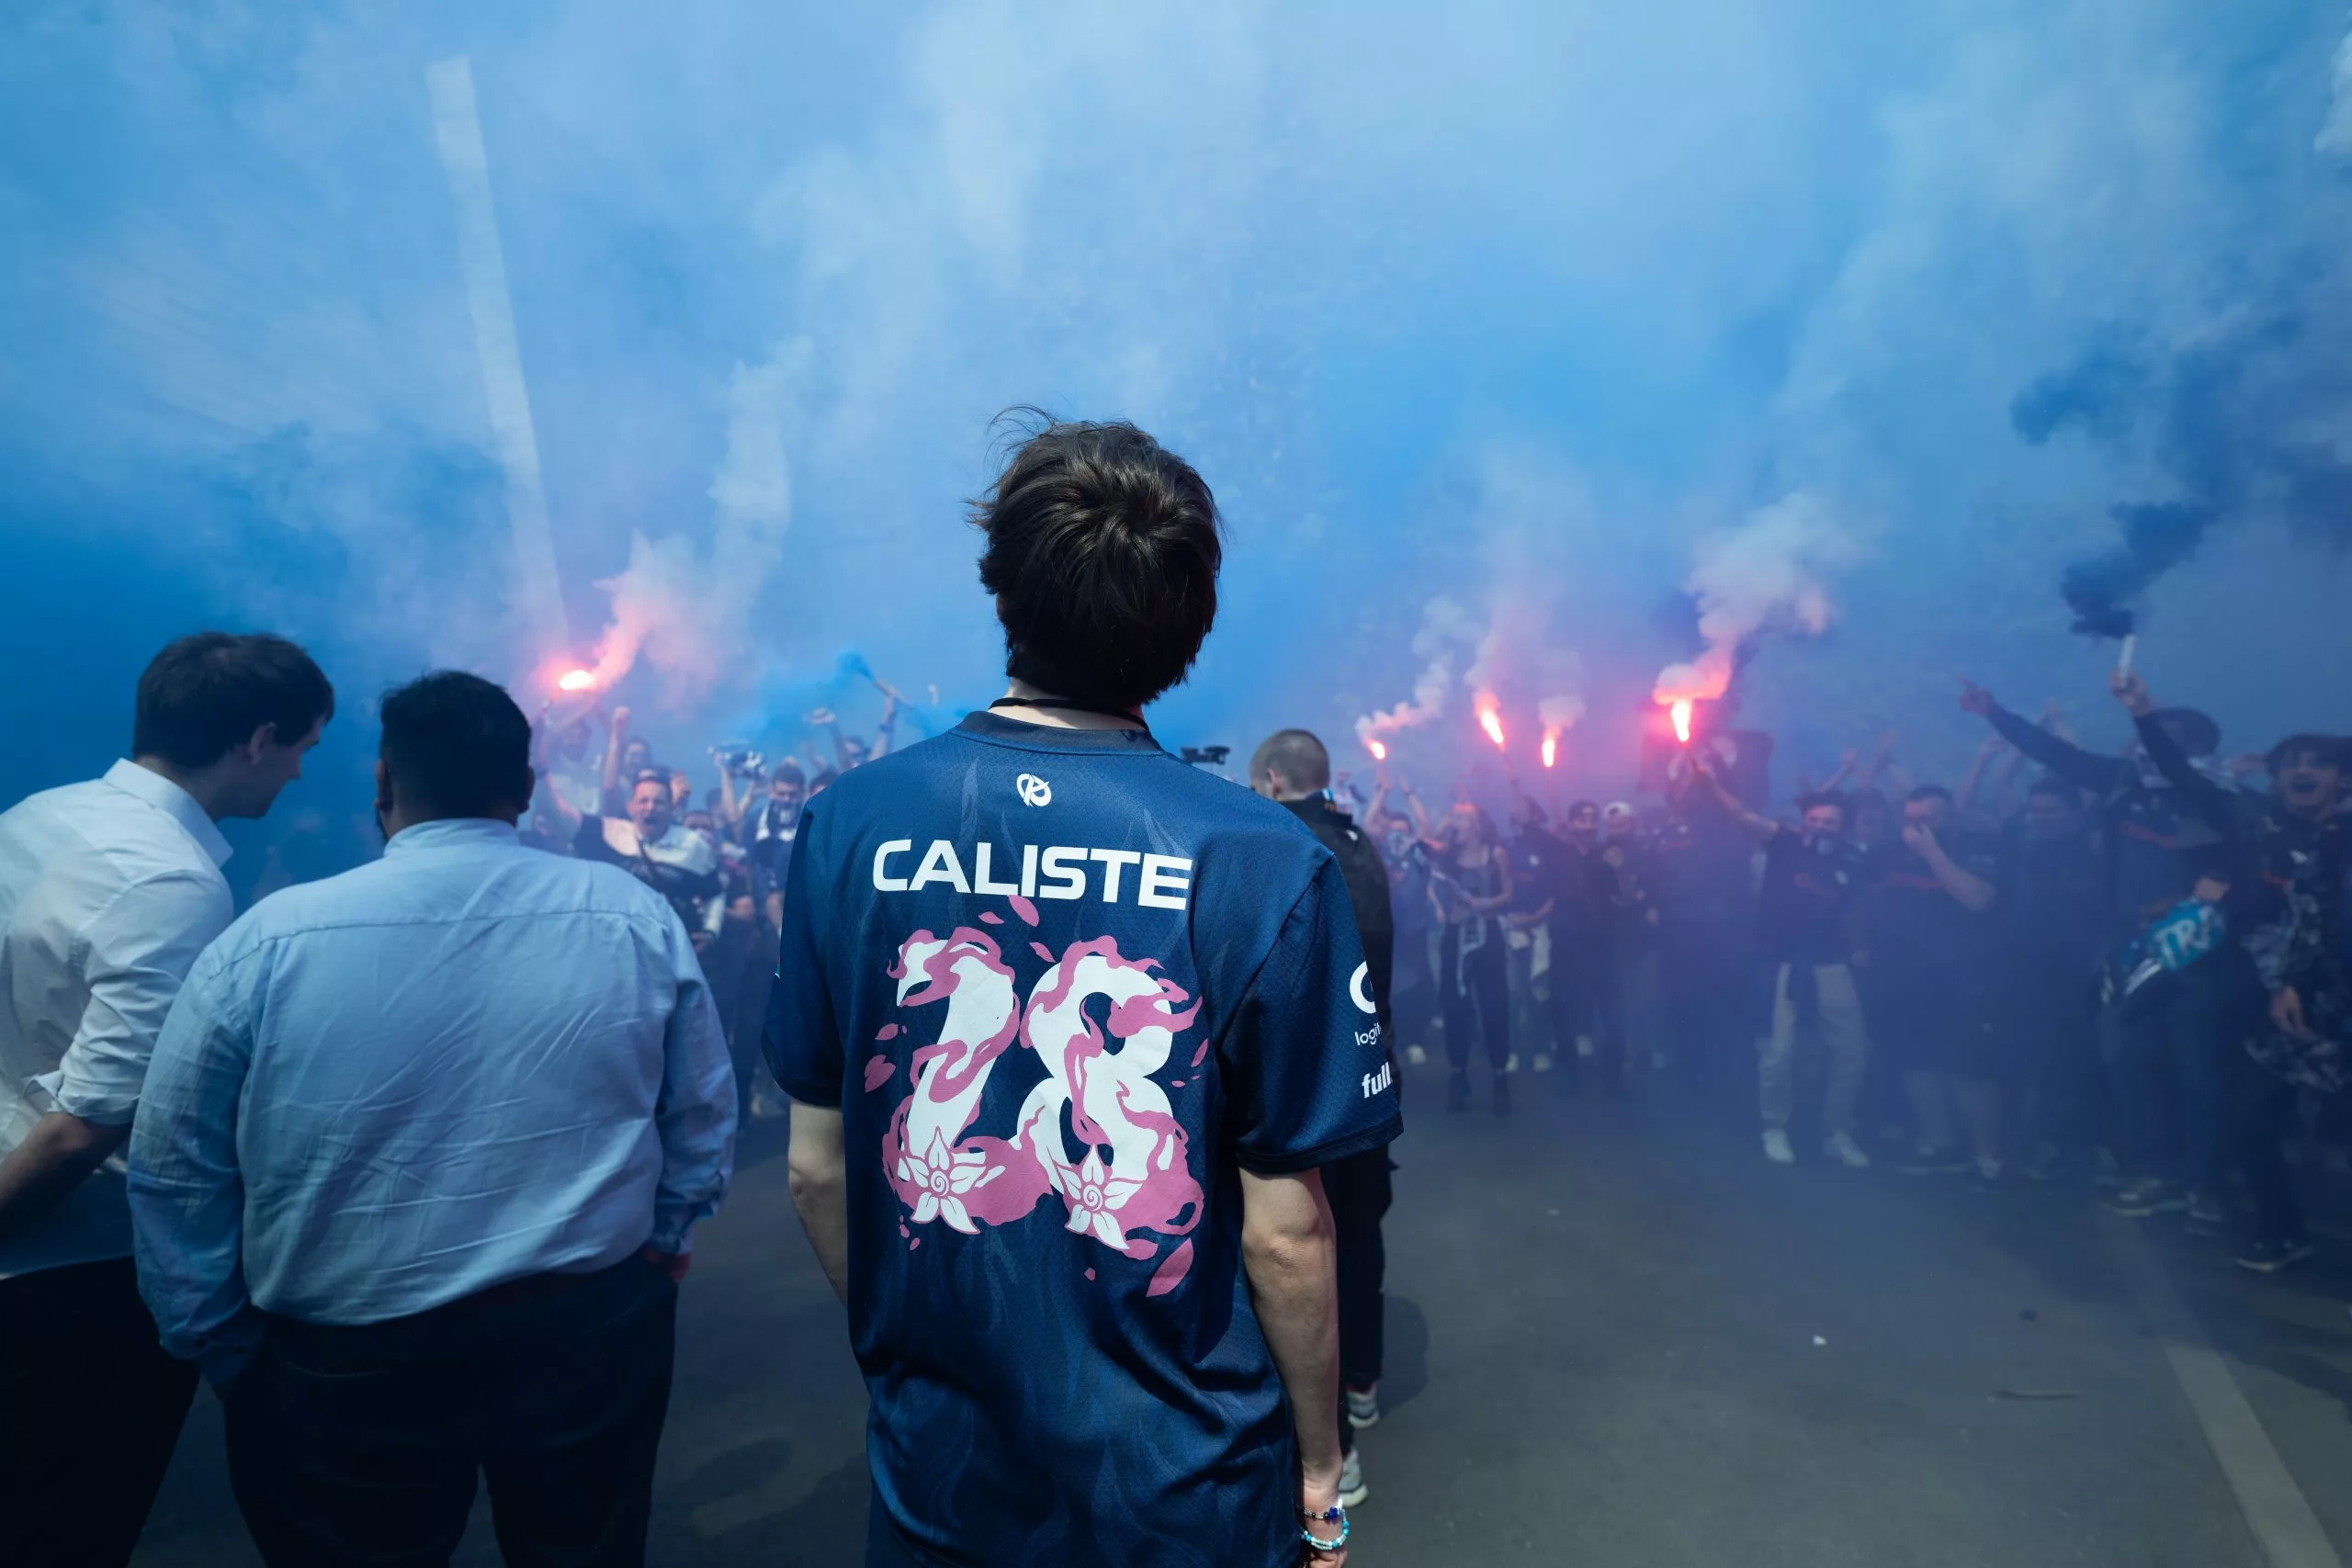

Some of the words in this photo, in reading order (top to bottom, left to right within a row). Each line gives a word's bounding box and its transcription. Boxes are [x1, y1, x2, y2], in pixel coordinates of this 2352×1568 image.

[872, 840, 1193, 910] CALISTE
[1354, 1021, 1382, 1045] logit
[889, 930, 1200, 1253] 28
